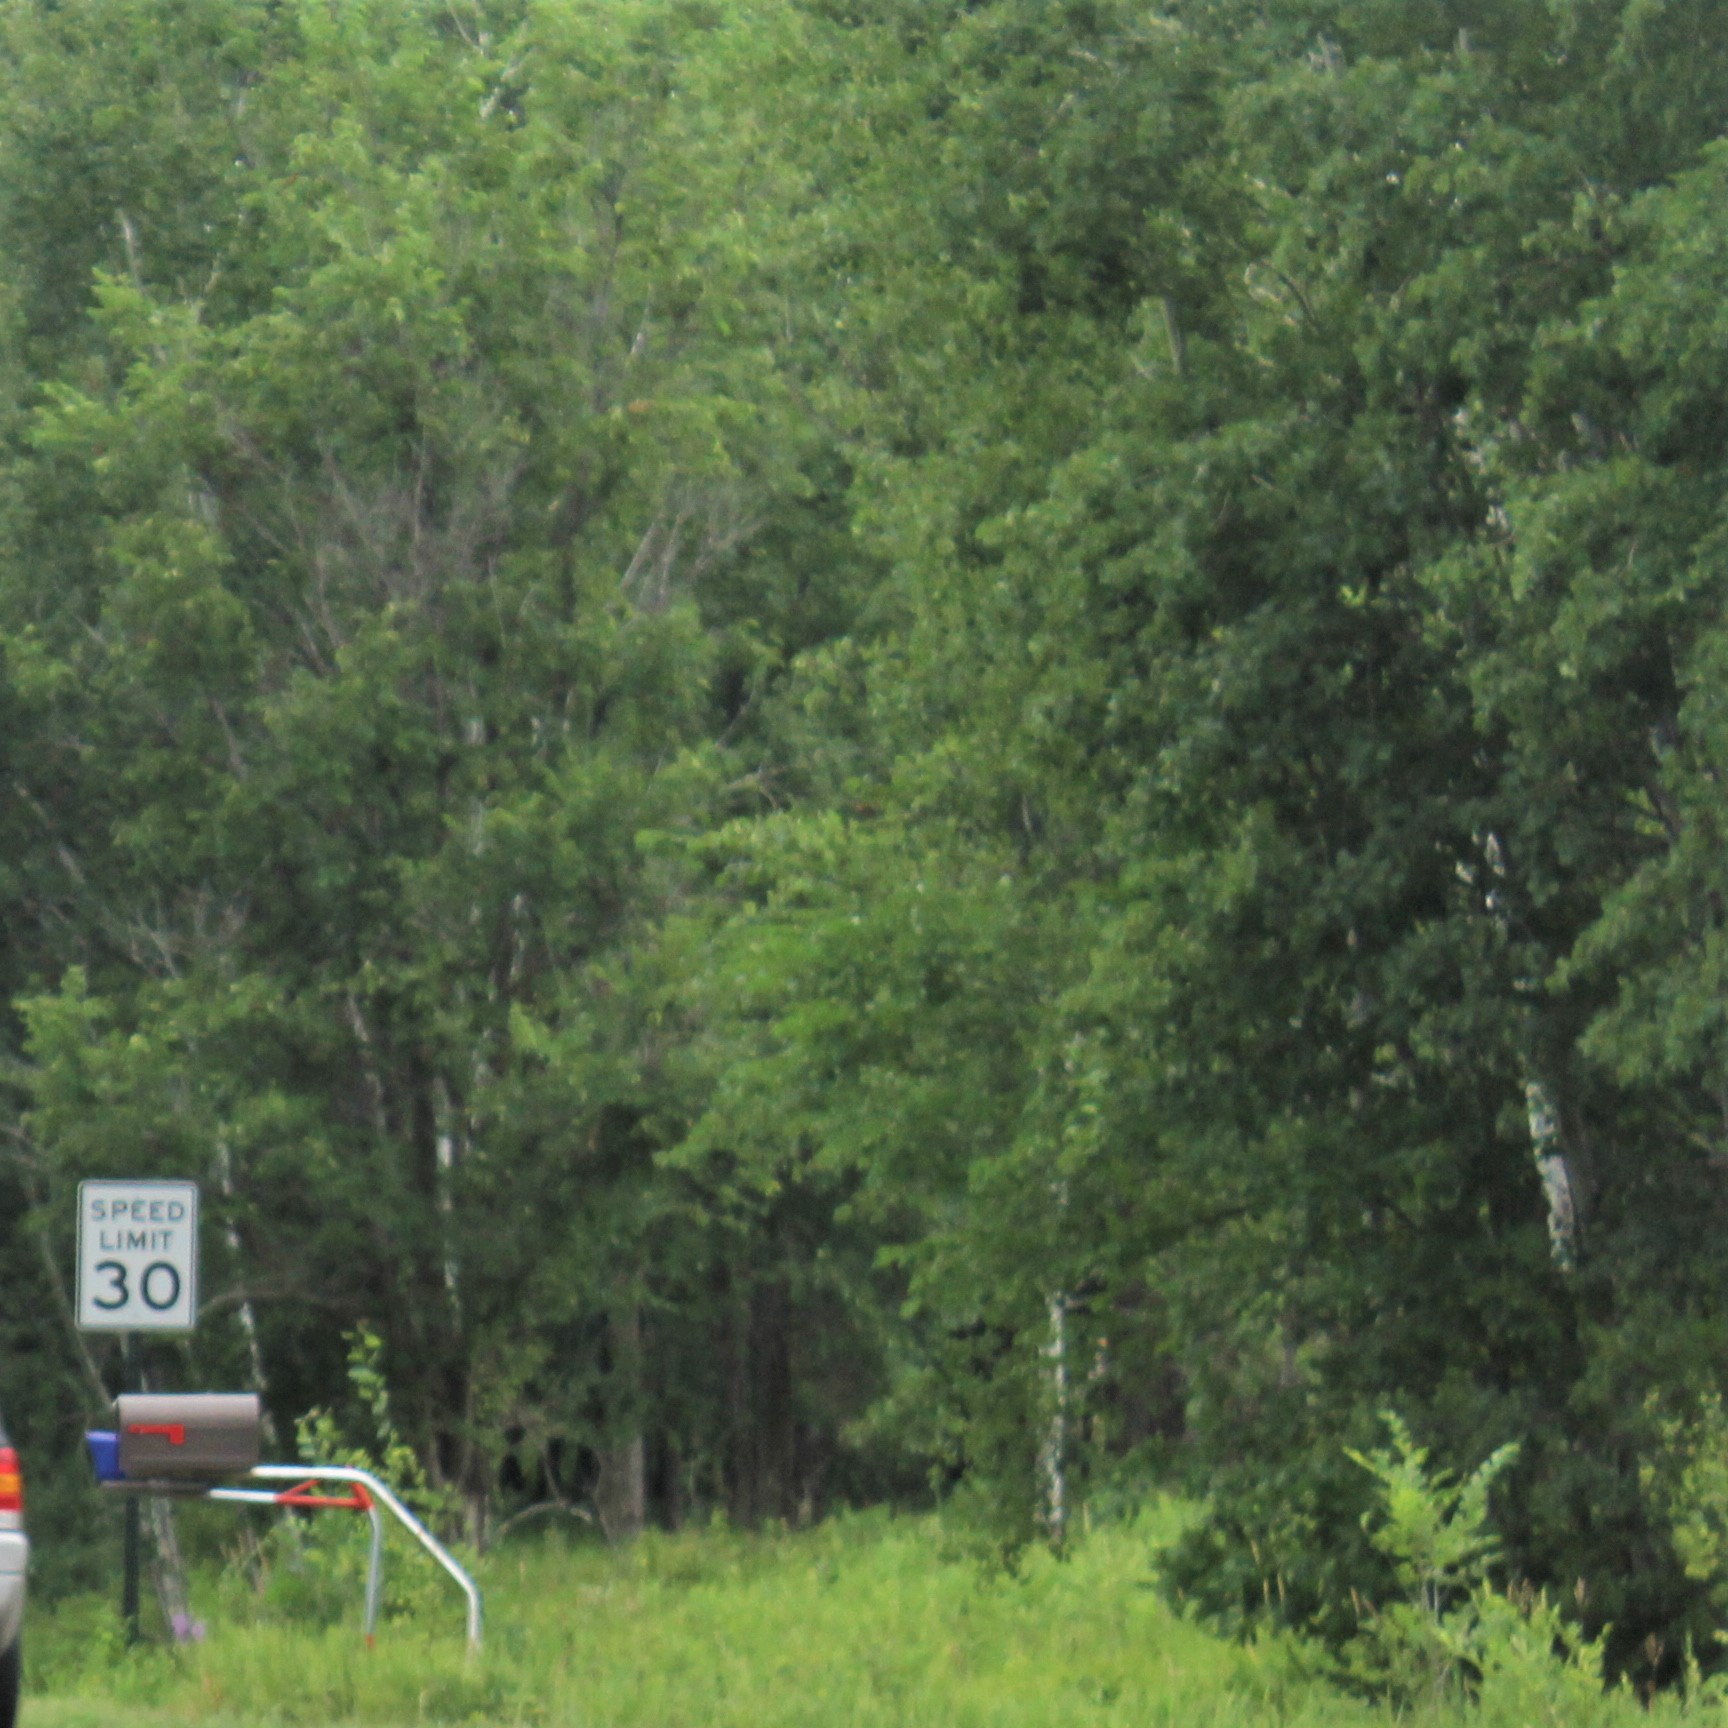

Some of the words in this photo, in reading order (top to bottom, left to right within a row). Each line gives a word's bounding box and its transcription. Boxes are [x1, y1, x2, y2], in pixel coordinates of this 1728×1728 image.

[91, 1199, 185, 1222] SPEED
[100, 1230, 173, 1251] LIMIT
[93, 1259, 181, 1311] 30
